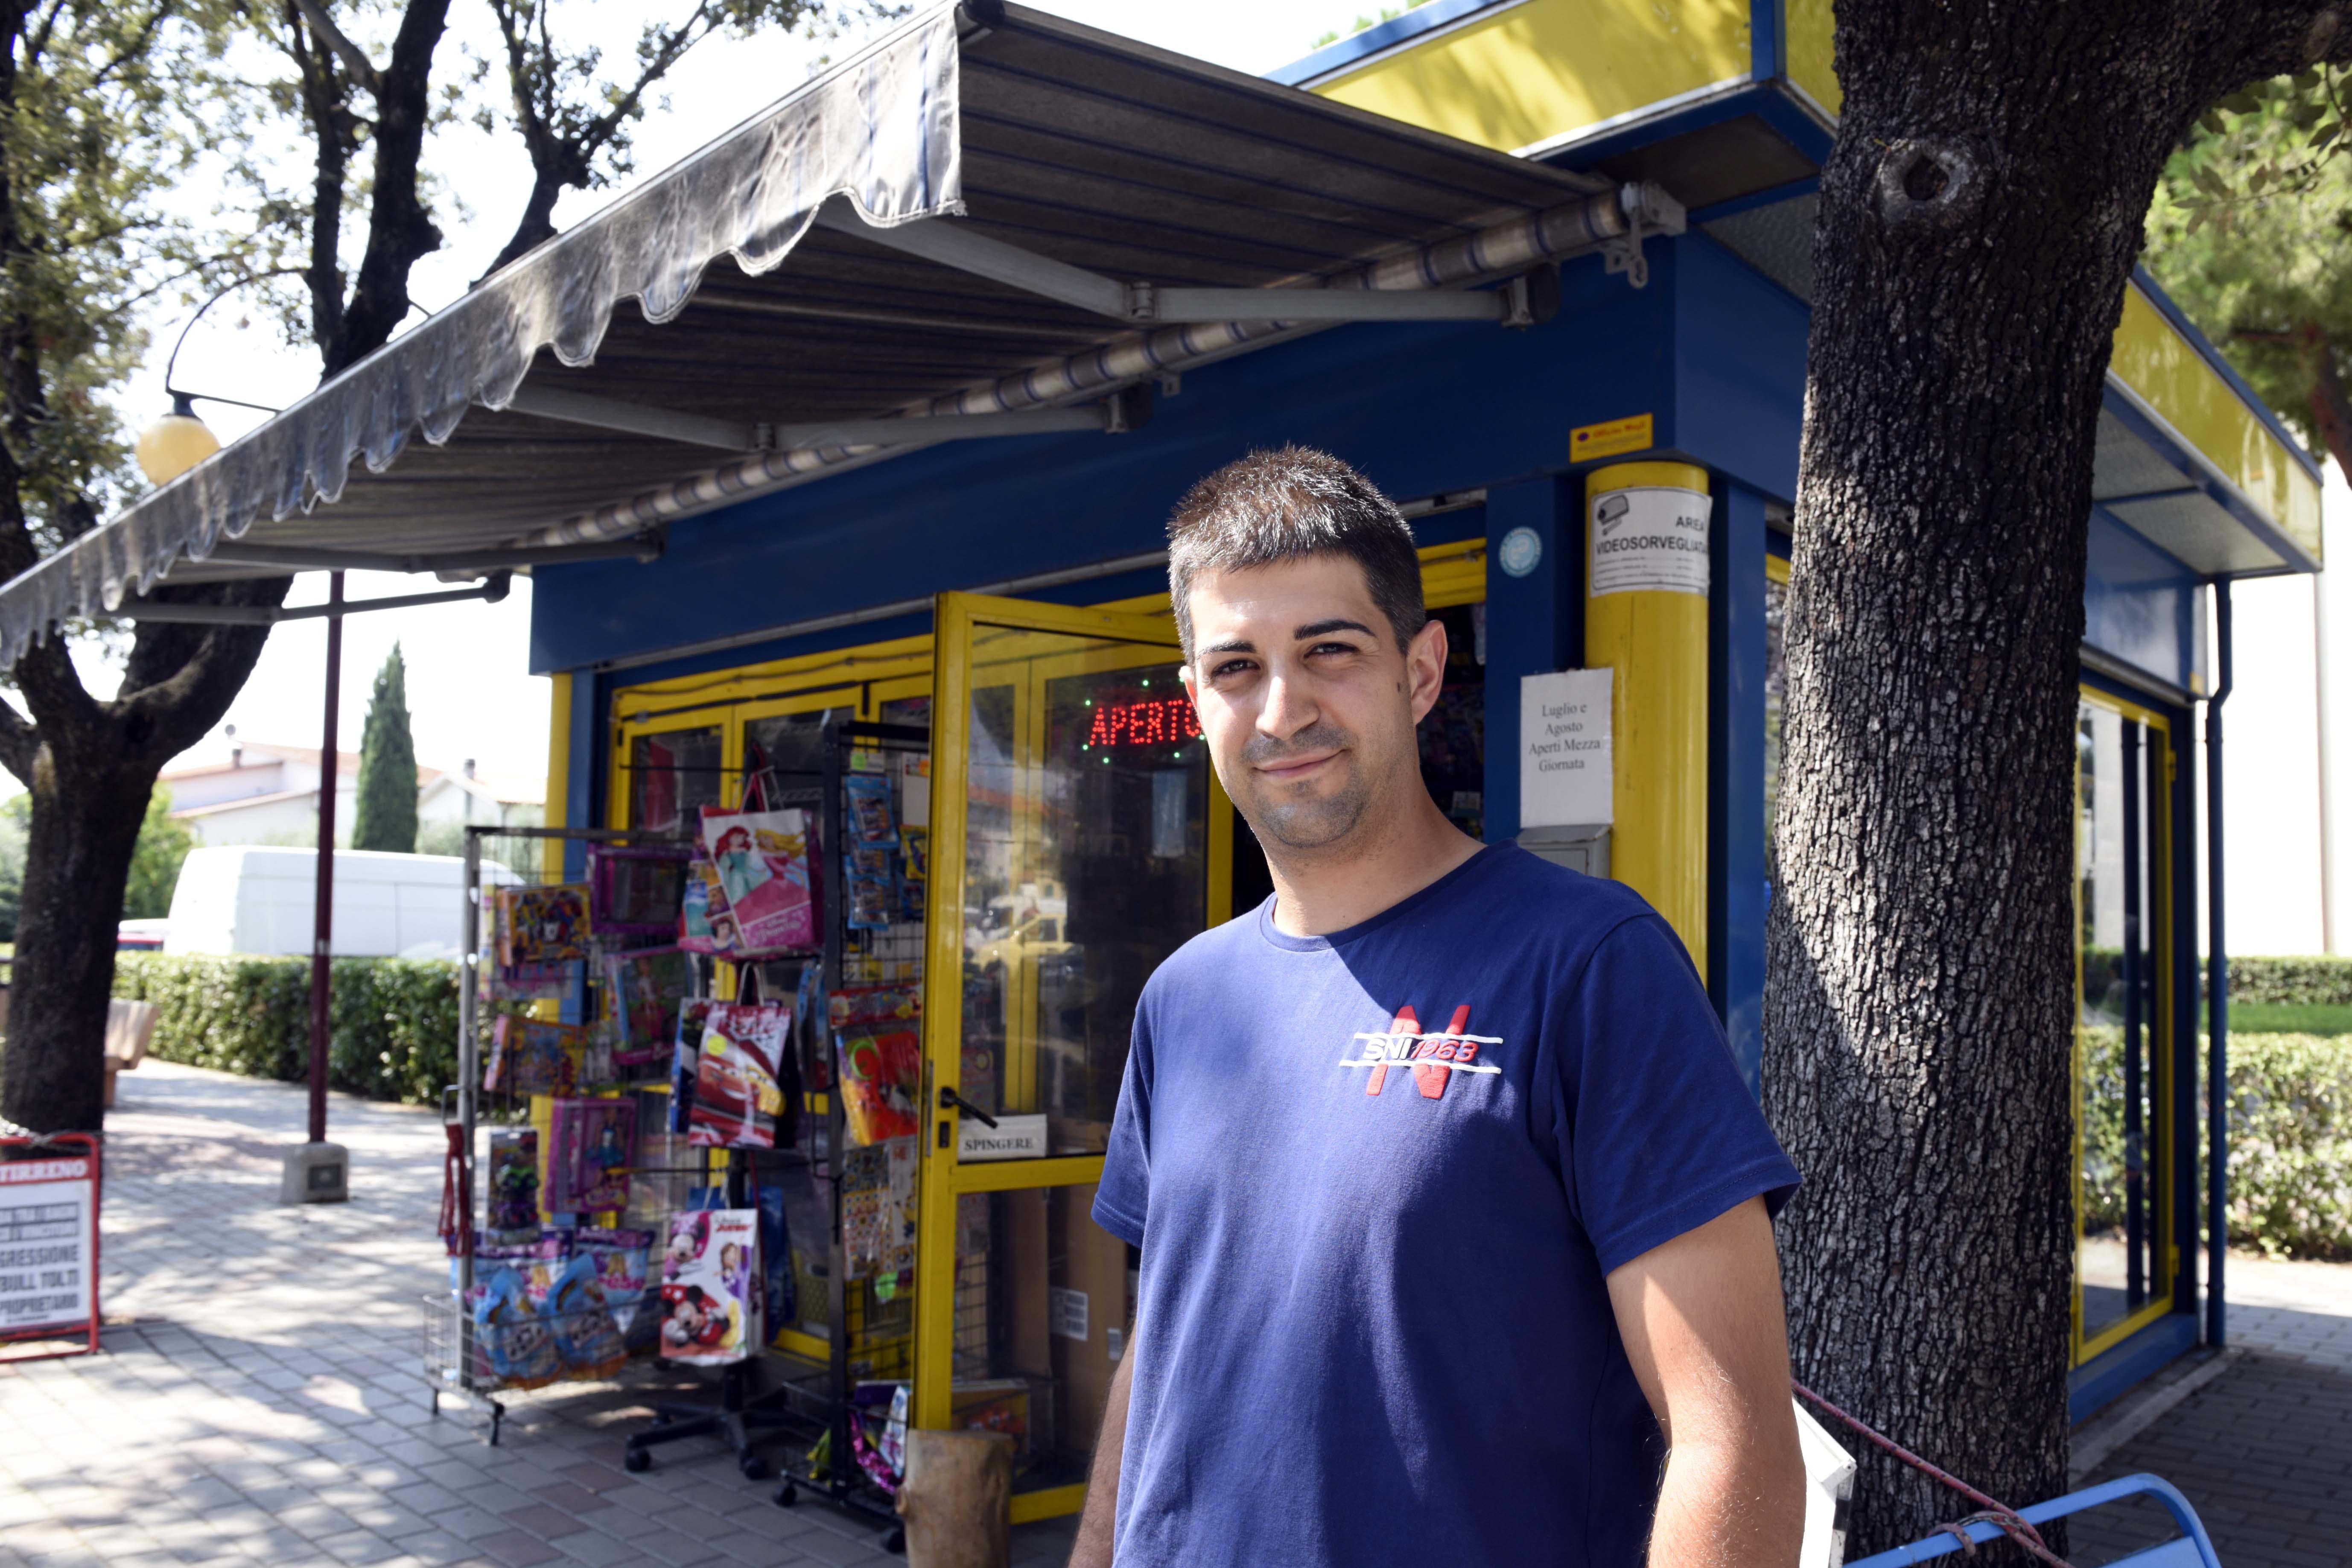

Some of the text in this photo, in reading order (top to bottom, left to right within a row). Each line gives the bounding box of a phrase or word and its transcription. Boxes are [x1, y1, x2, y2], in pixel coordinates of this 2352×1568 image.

[1675, 515, 1704, 531] AREA
[1542, 702, 1587, 719] Luglio e
[1089, 699, 1202, 745] APERTO
[1545, 722, 1583, 737] Agosto
[1529, 739, 1601, 757] Aperti Mezza
[1538, 759, 1585, 773] Giornata
[1363, 1037, 1479, 1063] SNI 1963
[964, 1137, 1033, 1151] SPINGERE
[0, 1159, 88, 1183] TIRRENO
